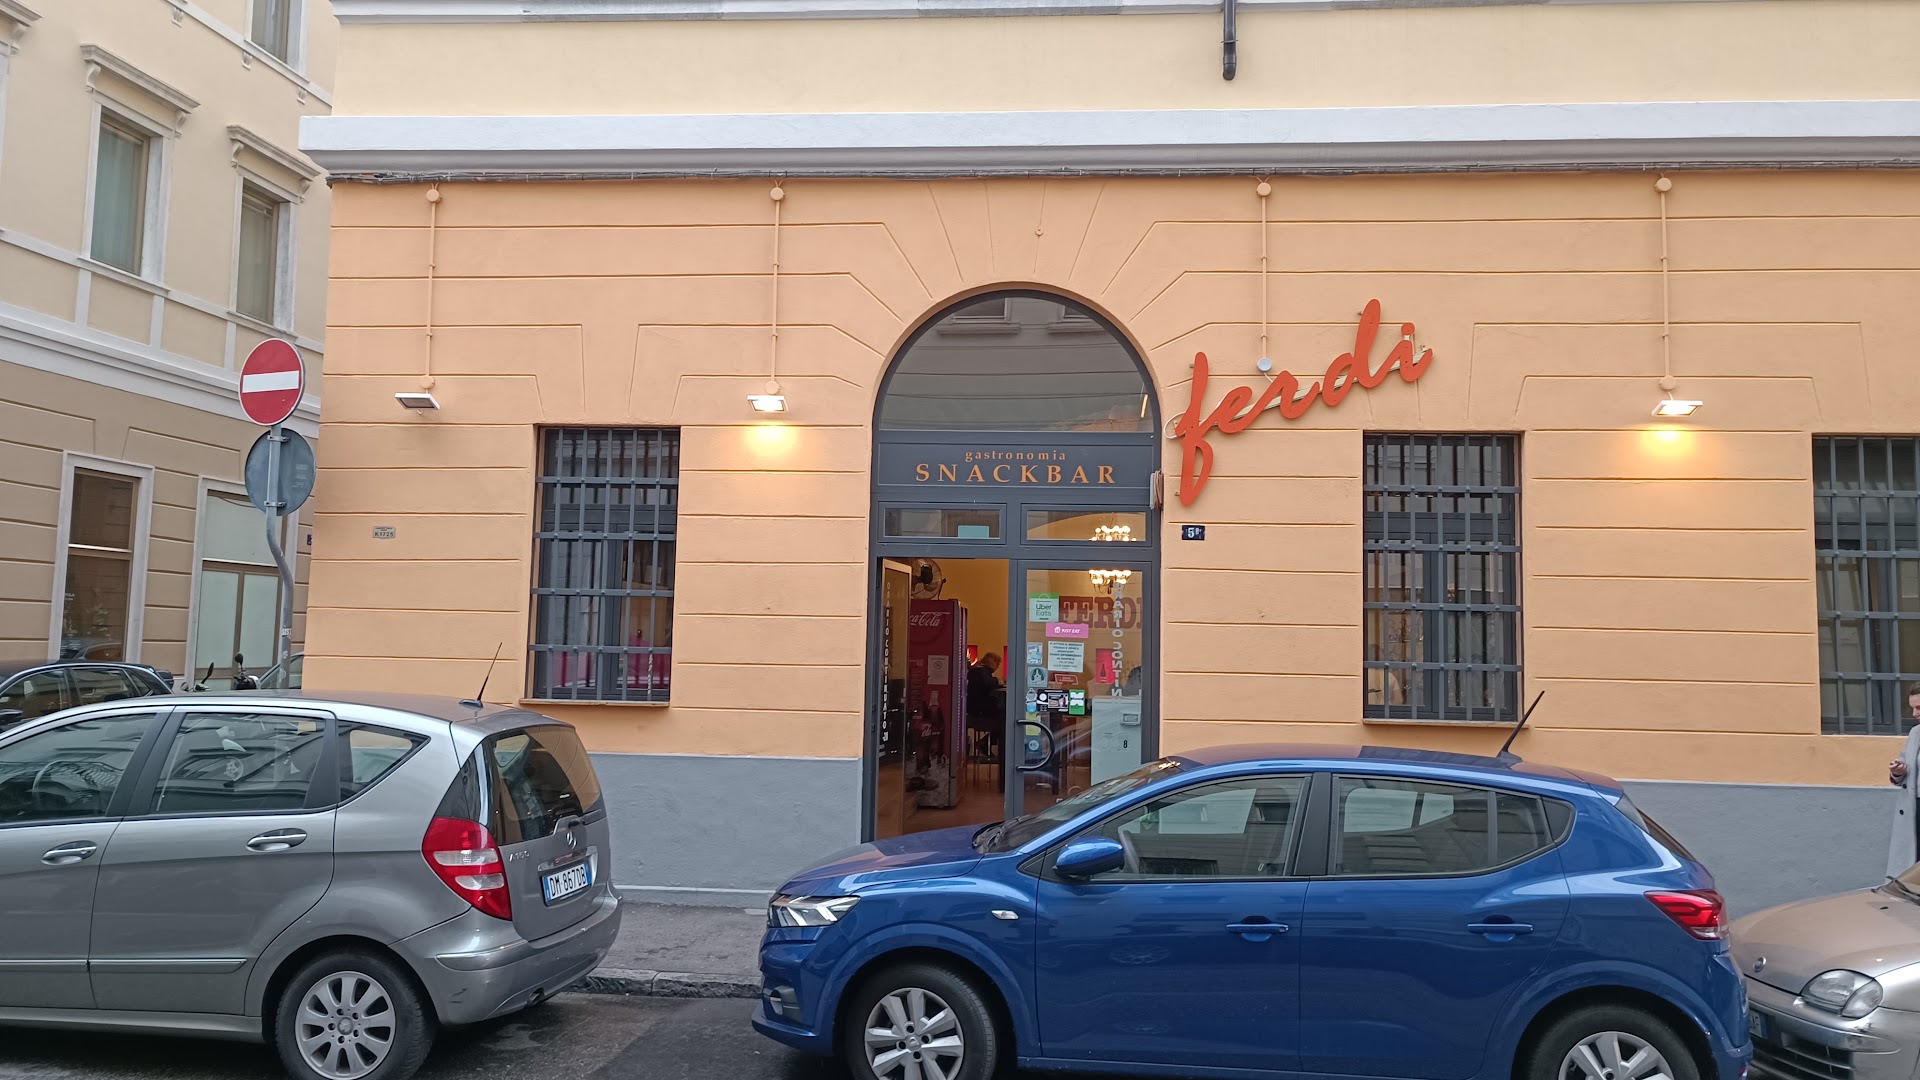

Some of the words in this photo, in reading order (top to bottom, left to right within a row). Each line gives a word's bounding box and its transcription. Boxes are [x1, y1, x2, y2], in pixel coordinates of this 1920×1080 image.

[1175, 299, 1433, 507] ferdi
[965, 450, 1066, 463] gastronomia
[915, 463, 1116, 484] SNACKBAR
[909, 612, 950, 626] ca-Cola
